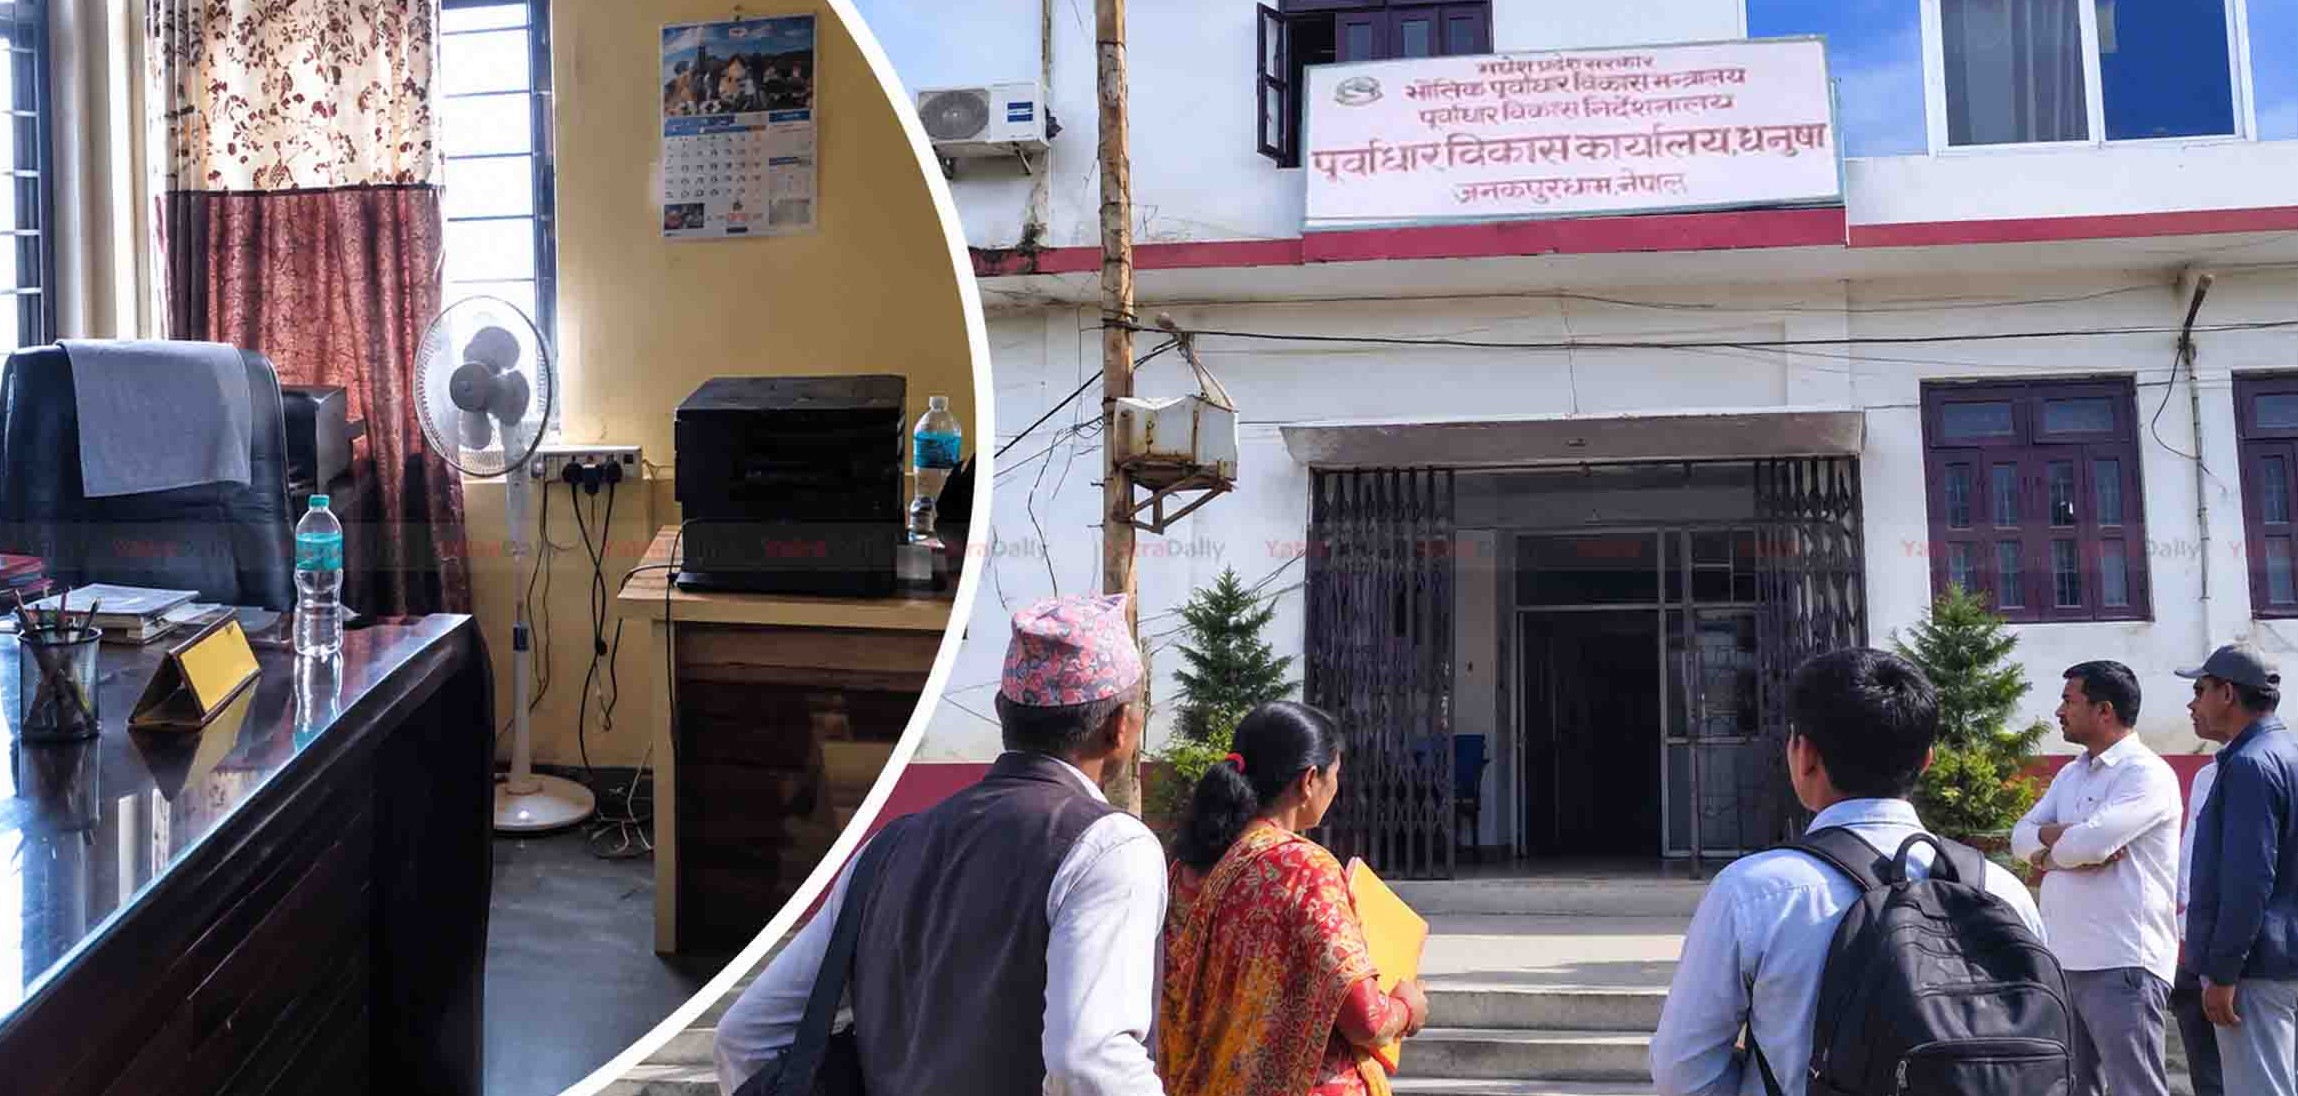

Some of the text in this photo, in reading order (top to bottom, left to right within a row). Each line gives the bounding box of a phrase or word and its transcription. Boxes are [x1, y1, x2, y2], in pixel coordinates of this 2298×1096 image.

[1573, 72, 1648, 94] विकास
[1312, 138, 1445, 184] पूर्वाधार
[1445, 132, 1571, 169] विकास
